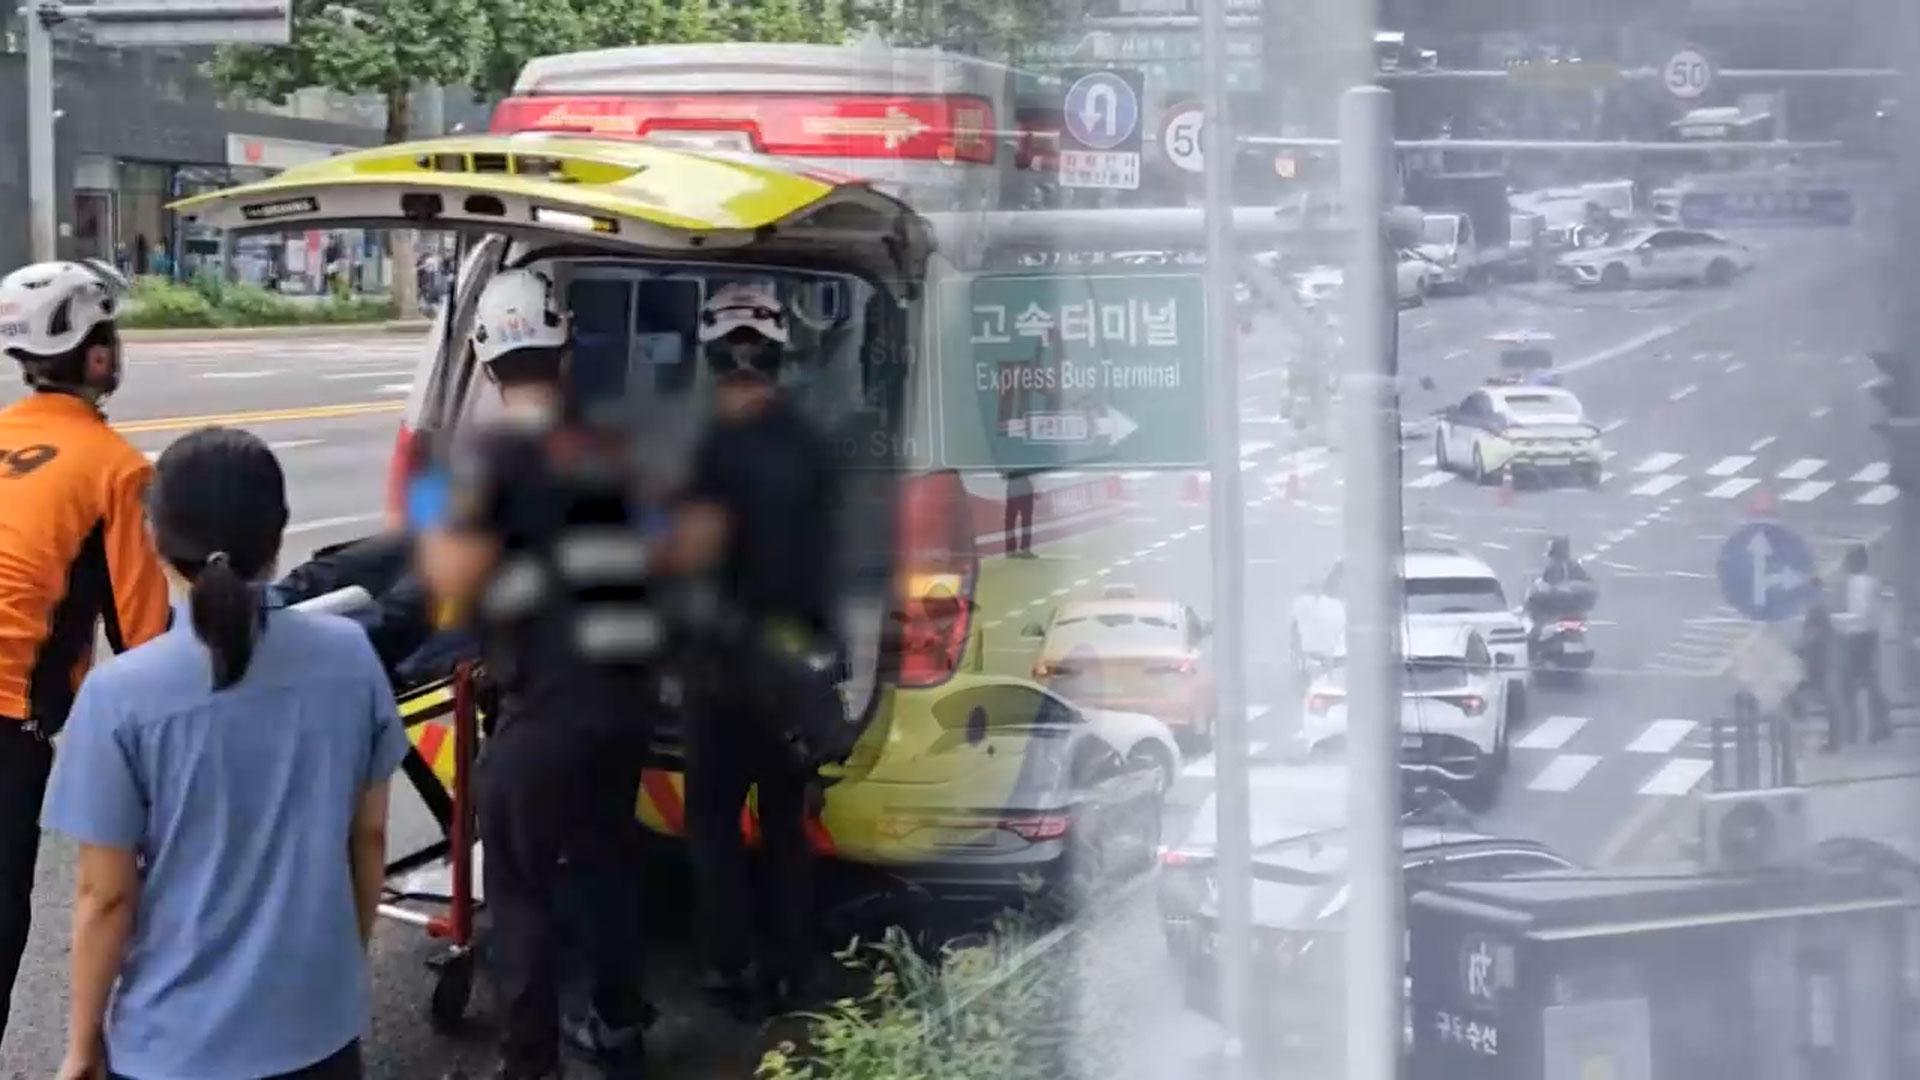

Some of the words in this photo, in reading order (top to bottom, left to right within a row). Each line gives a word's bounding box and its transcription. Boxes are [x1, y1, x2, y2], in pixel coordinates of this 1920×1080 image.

[1671, 62, 1705, 87] 50
[970, 298, 1178, 348] 고속터미널
[976, 360, 1056, 394] Express
[1061, 359, 1096, 389] Bus
[1101, 359, 1180, 389] Terminal
